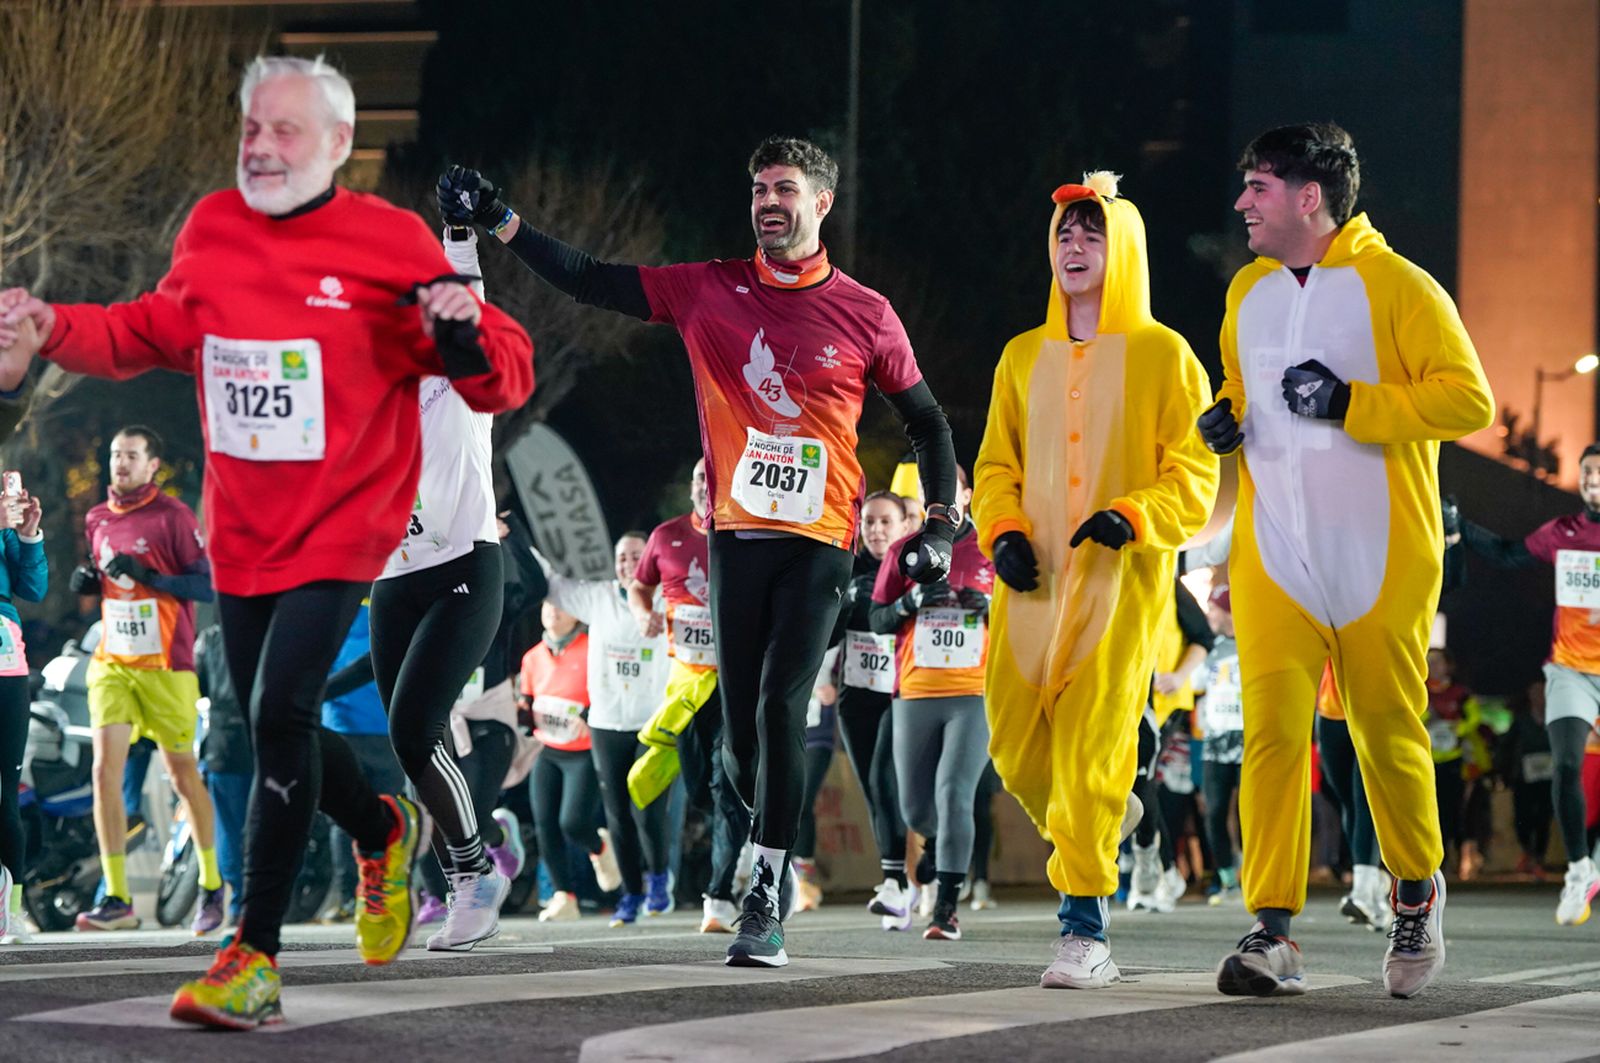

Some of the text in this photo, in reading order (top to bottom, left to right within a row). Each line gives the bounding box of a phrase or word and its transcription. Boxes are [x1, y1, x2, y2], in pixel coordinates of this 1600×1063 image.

[758, 377, 782, 402] 43
[225, 382, 292, 418] 3125
[745, 449, 762, 459] SAN
[763, 452, 794, 464] ANTÓN
[754, 443, 794, 454] NOCHE DE
[749, 461, 808, 494] 2037
[1565, 571, 1600, 588] 3656
[116, 620, 146, 637] 4481
[684, 626, 715, 646] 215
[932, 628, 964, 648] 300
[616, 661, 640, 677] 169
[860, 652, 889, 671] 302
